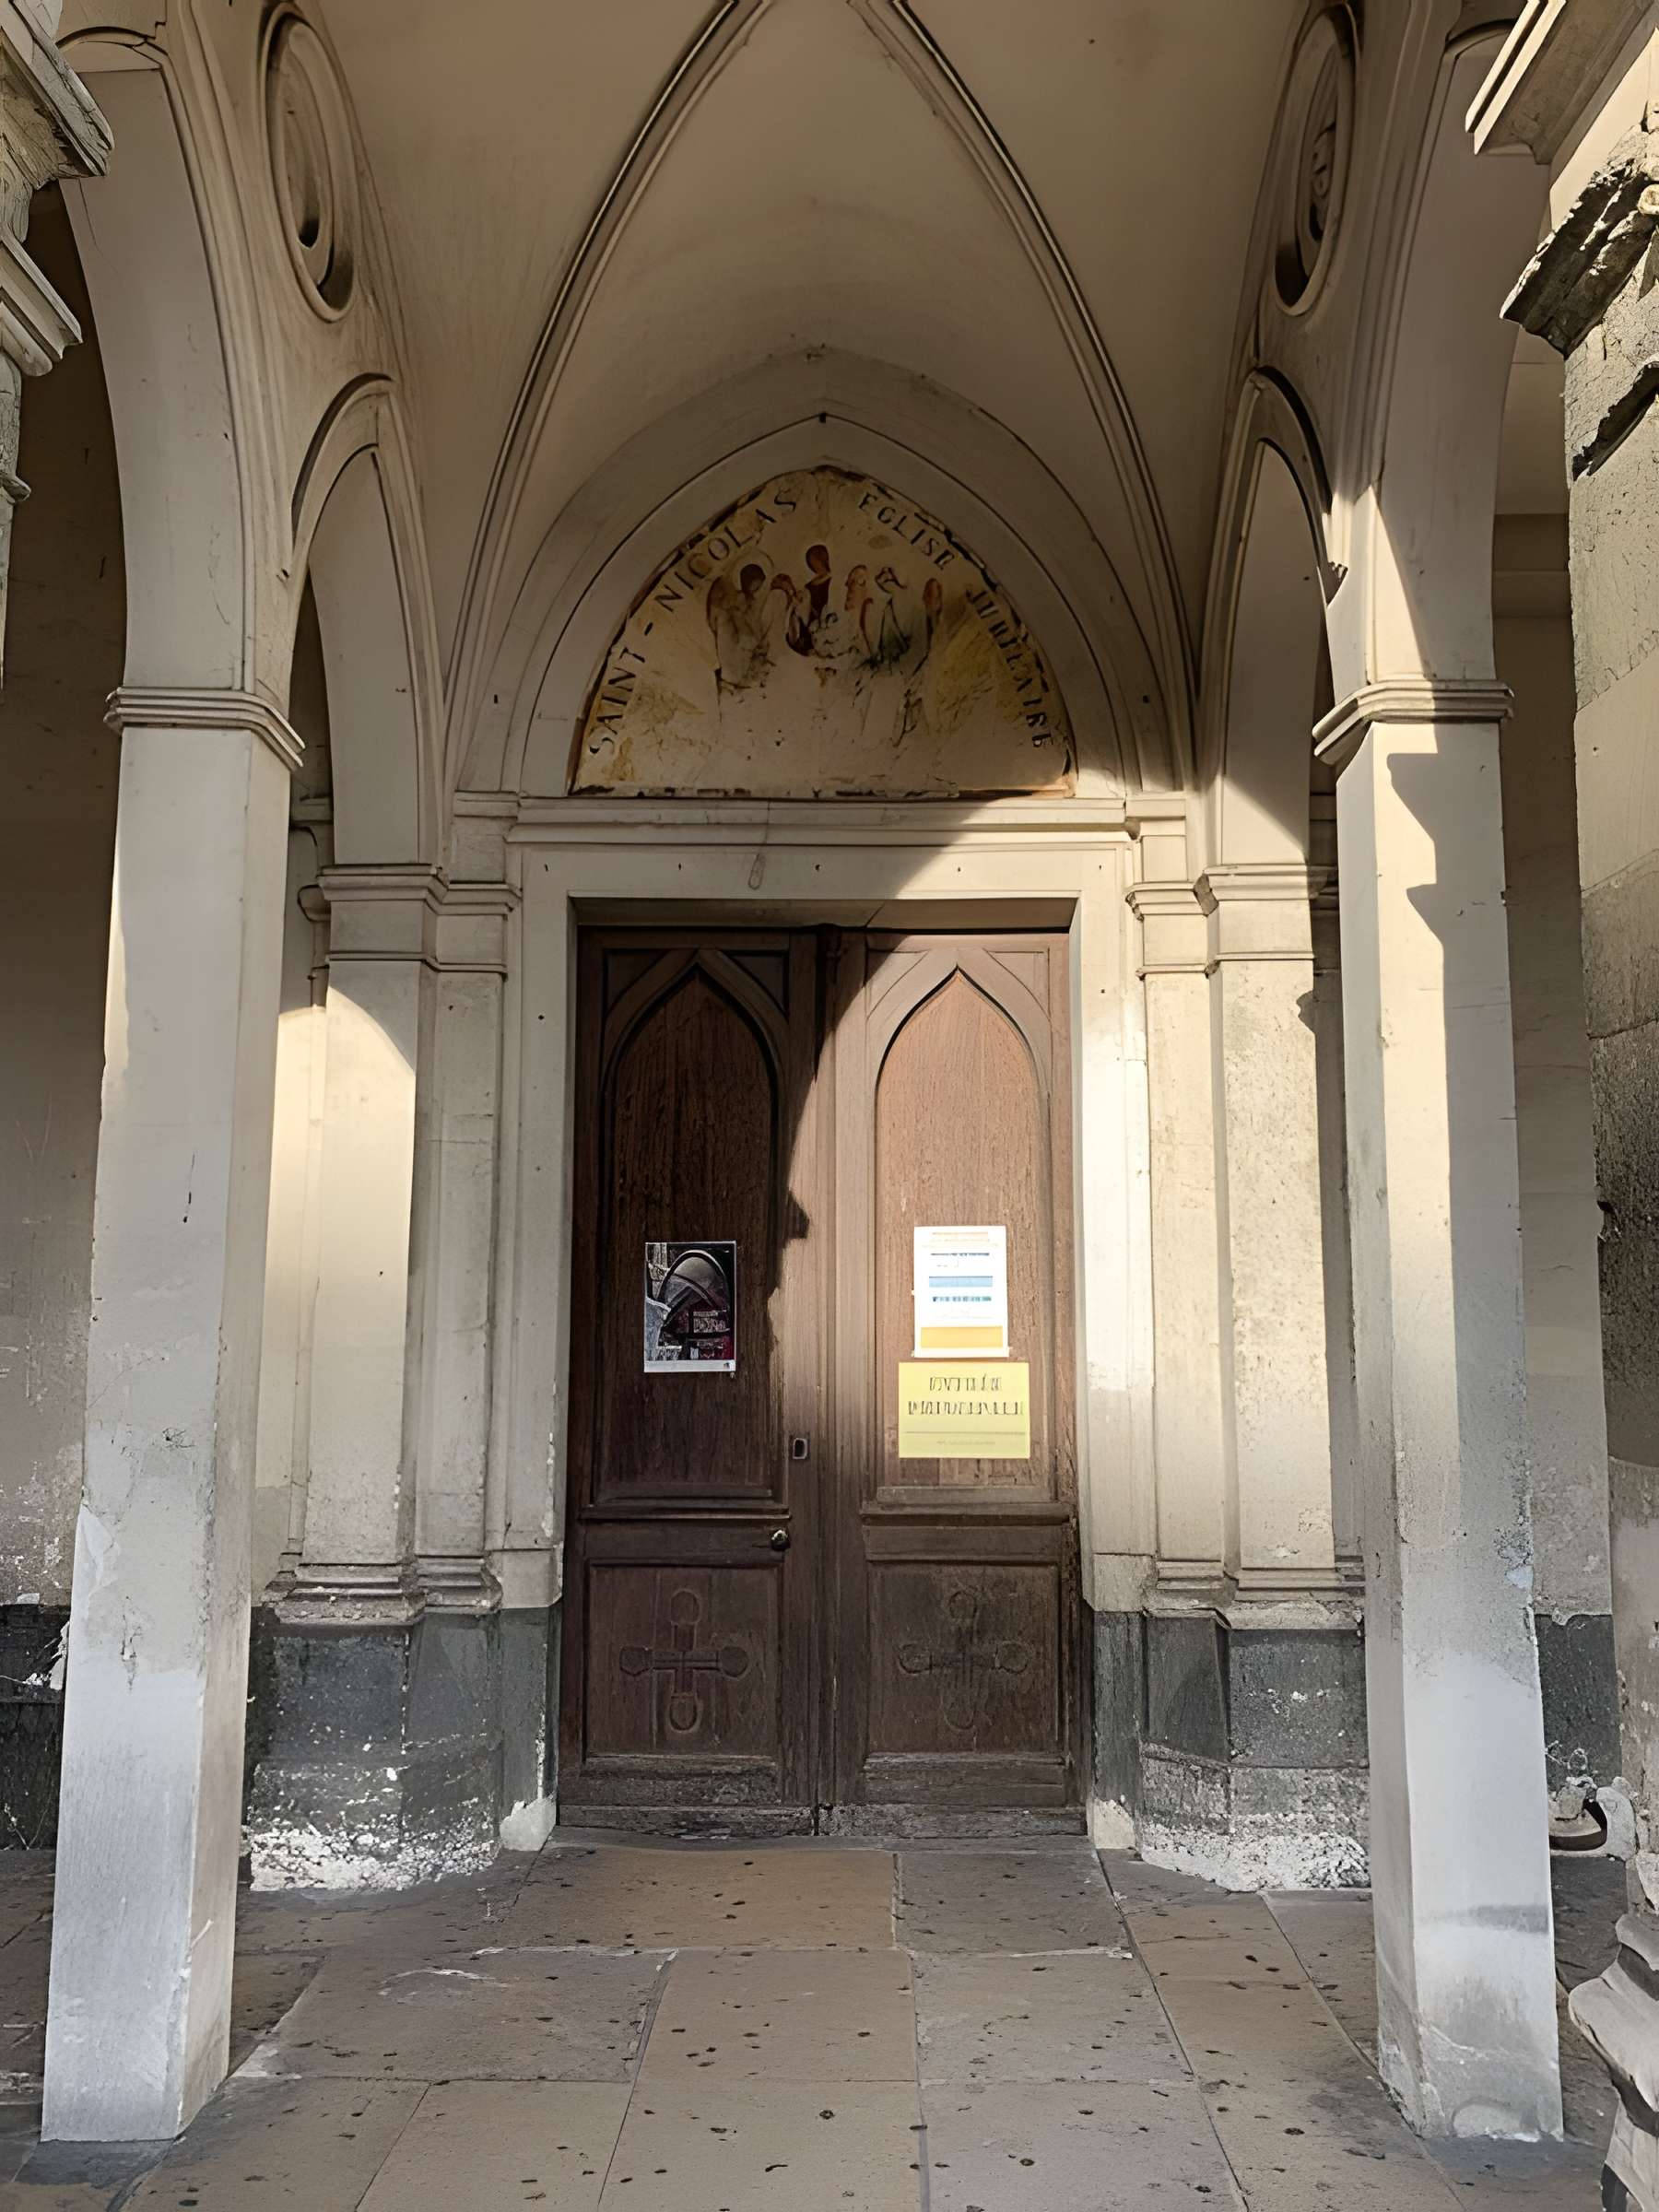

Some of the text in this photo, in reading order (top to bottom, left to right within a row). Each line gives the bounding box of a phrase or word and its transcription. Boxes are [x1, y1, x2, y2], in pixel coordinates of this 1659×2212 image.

[858, 492, 956, 571] EGLISE
[589, 644, 646, 756] SAINT
[653, 488, 797, 612] NICOLAS
